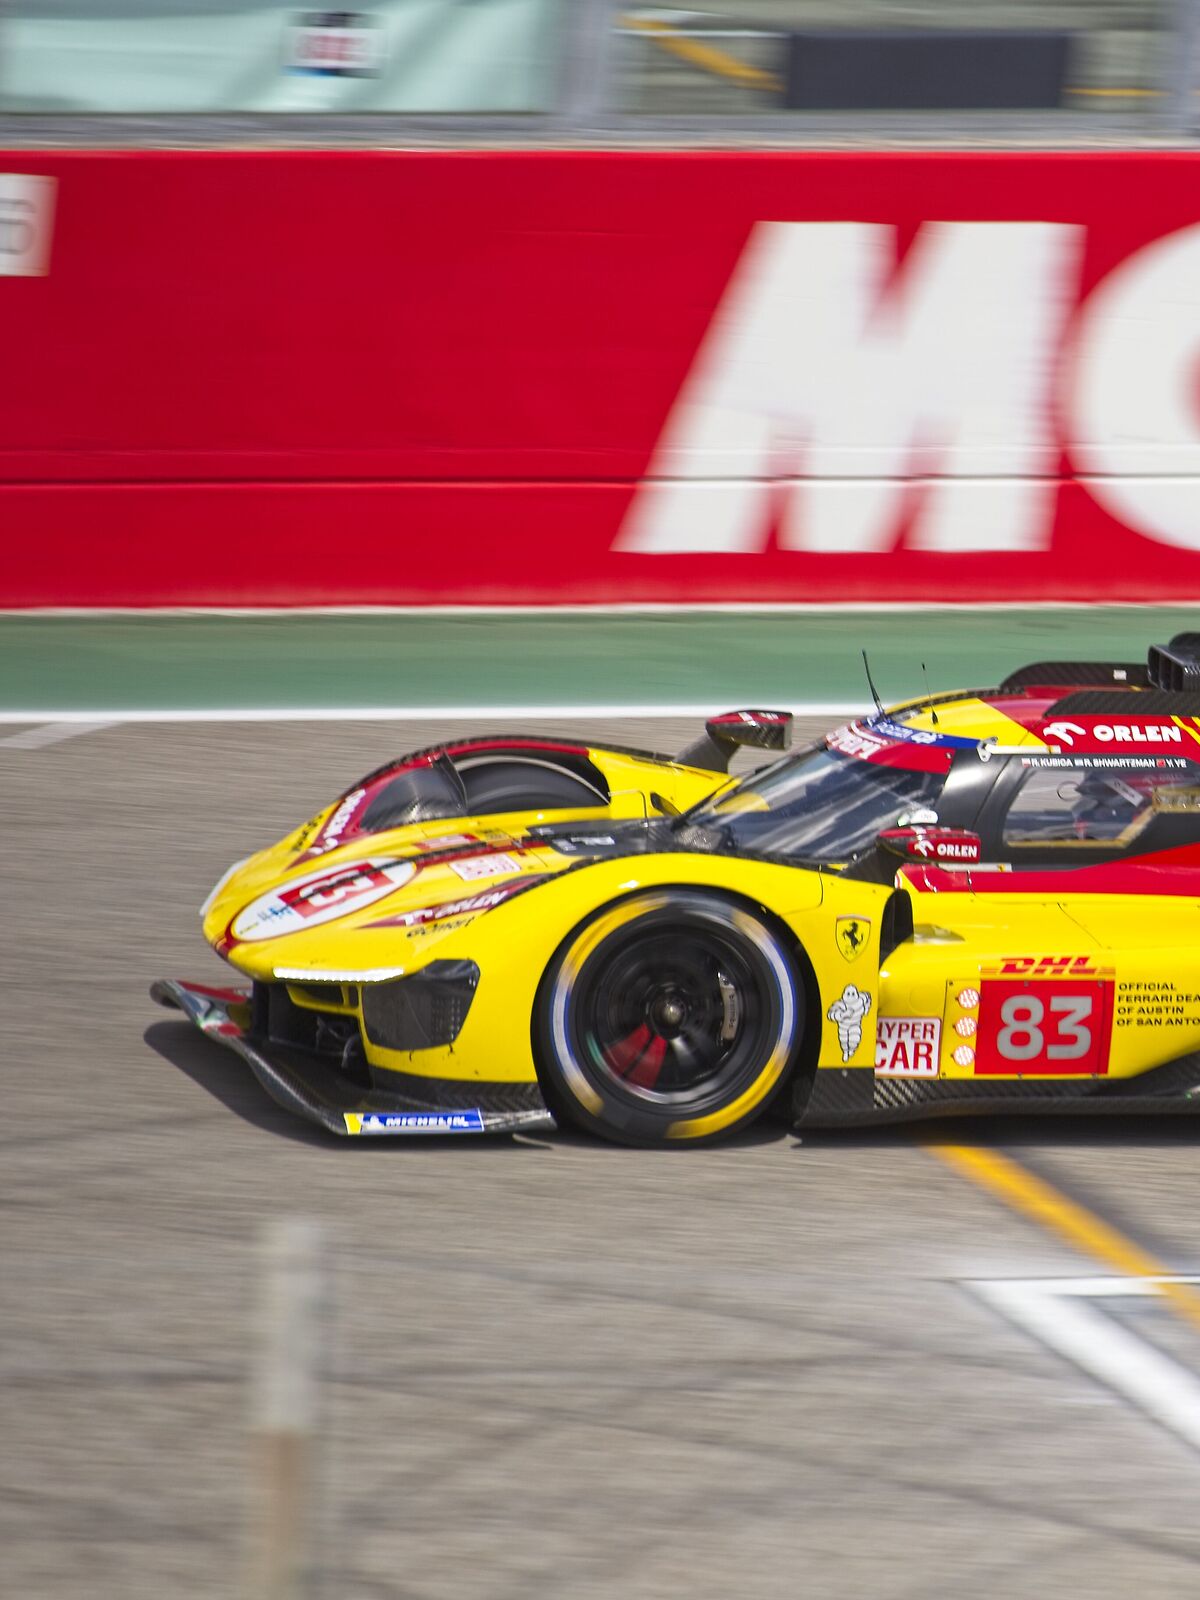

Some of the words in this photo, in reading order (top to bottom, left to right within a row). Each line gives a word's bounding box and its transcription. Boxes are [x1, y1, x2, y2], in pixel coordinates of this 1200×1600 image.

[1092, 724, 1182, 743] ORLEN
[936, 843, 978, 858] ORLEN
[1000, 956, 1098, 975] DHL
[1118, 982, 1177, 992] OFFICIAL
[1117, 993, 1173, 1003] FERRARI
[1117, 1006, 1134, 1015] OF
[1137, 1005, 1184, 1015] AUSTIN
[996, 994, 1093, 1061] 83
[1116, 1017, 1133, 1027] OF
[1135, 1017, 1162, 1027] SAN
[875, 1040, 934, 1070] CAR
[385, 1115, 468, 1127] MICHELIN
